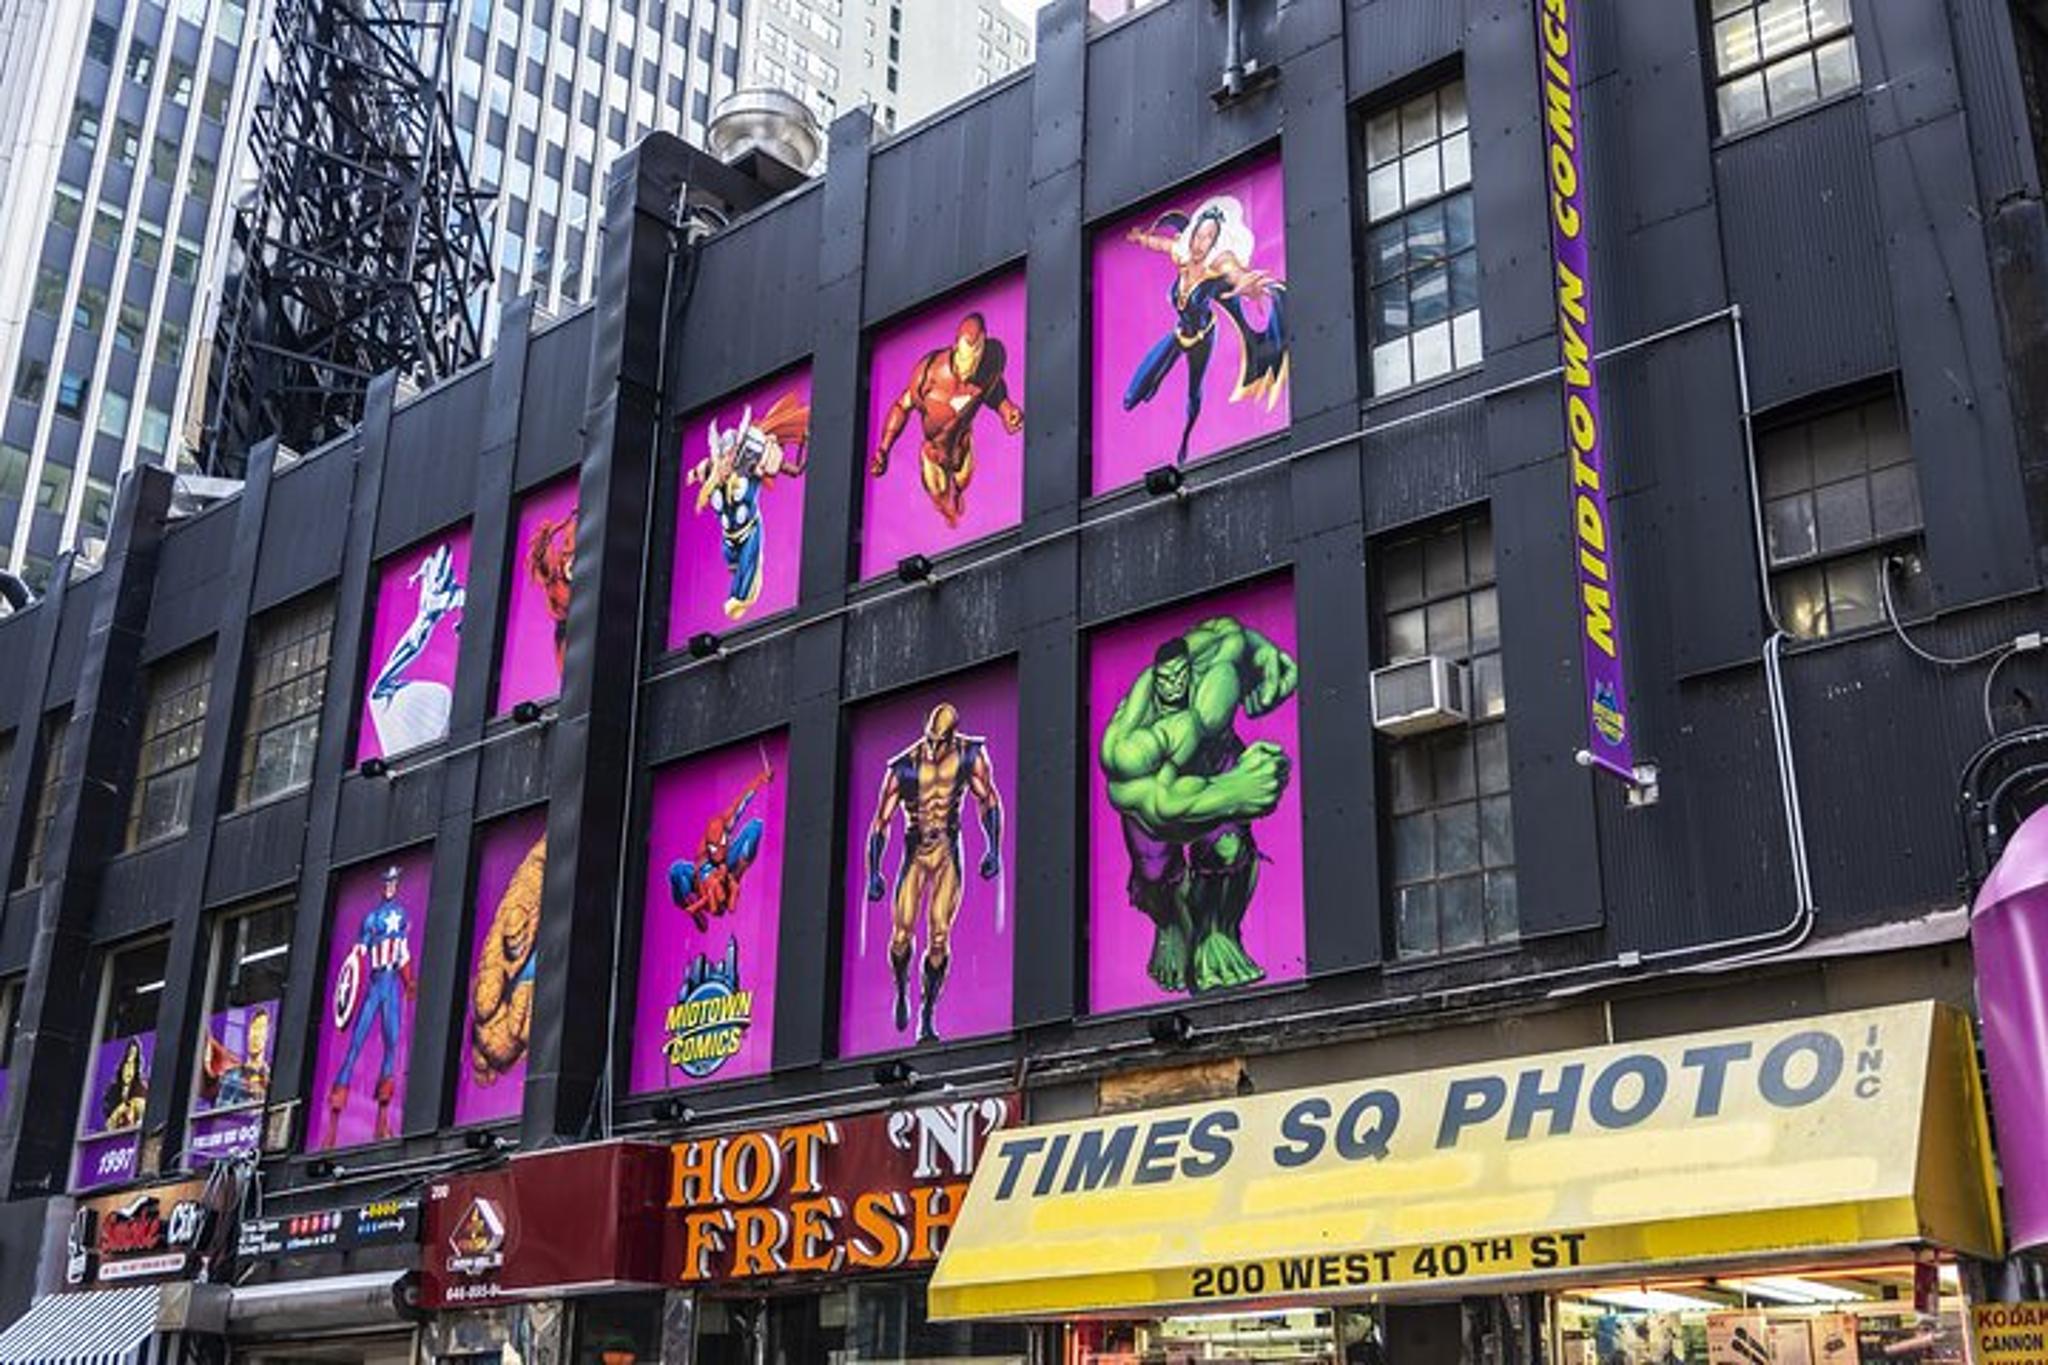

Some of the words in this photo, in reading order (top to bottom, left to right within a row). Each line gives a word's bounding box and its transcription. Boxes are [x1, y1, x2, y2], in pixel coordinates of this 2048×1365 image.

[1557, 262, 1617, 658] MIDTOWN
[665, 991, 753, 1031] MIDTOWN
[669, 1027, 742, 1066] COMICS
[1855, 1024, 1883, 1099] INC
[994, 1110, 1241, 1201] TIMES
[1273, 1089, 1401, 1169] SQ
[1434, 1030, 1845, 1150] PHOTO
[666, 1121, 840, 1208] HOT
[680, 1181, 970, 1281] FRESH
[1191, 1263, 1265, 1298] 200
[1279, 1250, 1396, 1289] WEST
[1412, 1236, 1512, 1278] 40TH
[1530, 1232, 1586, 1268] ST
[1981, 1333, 2043, 1353] CANNON
